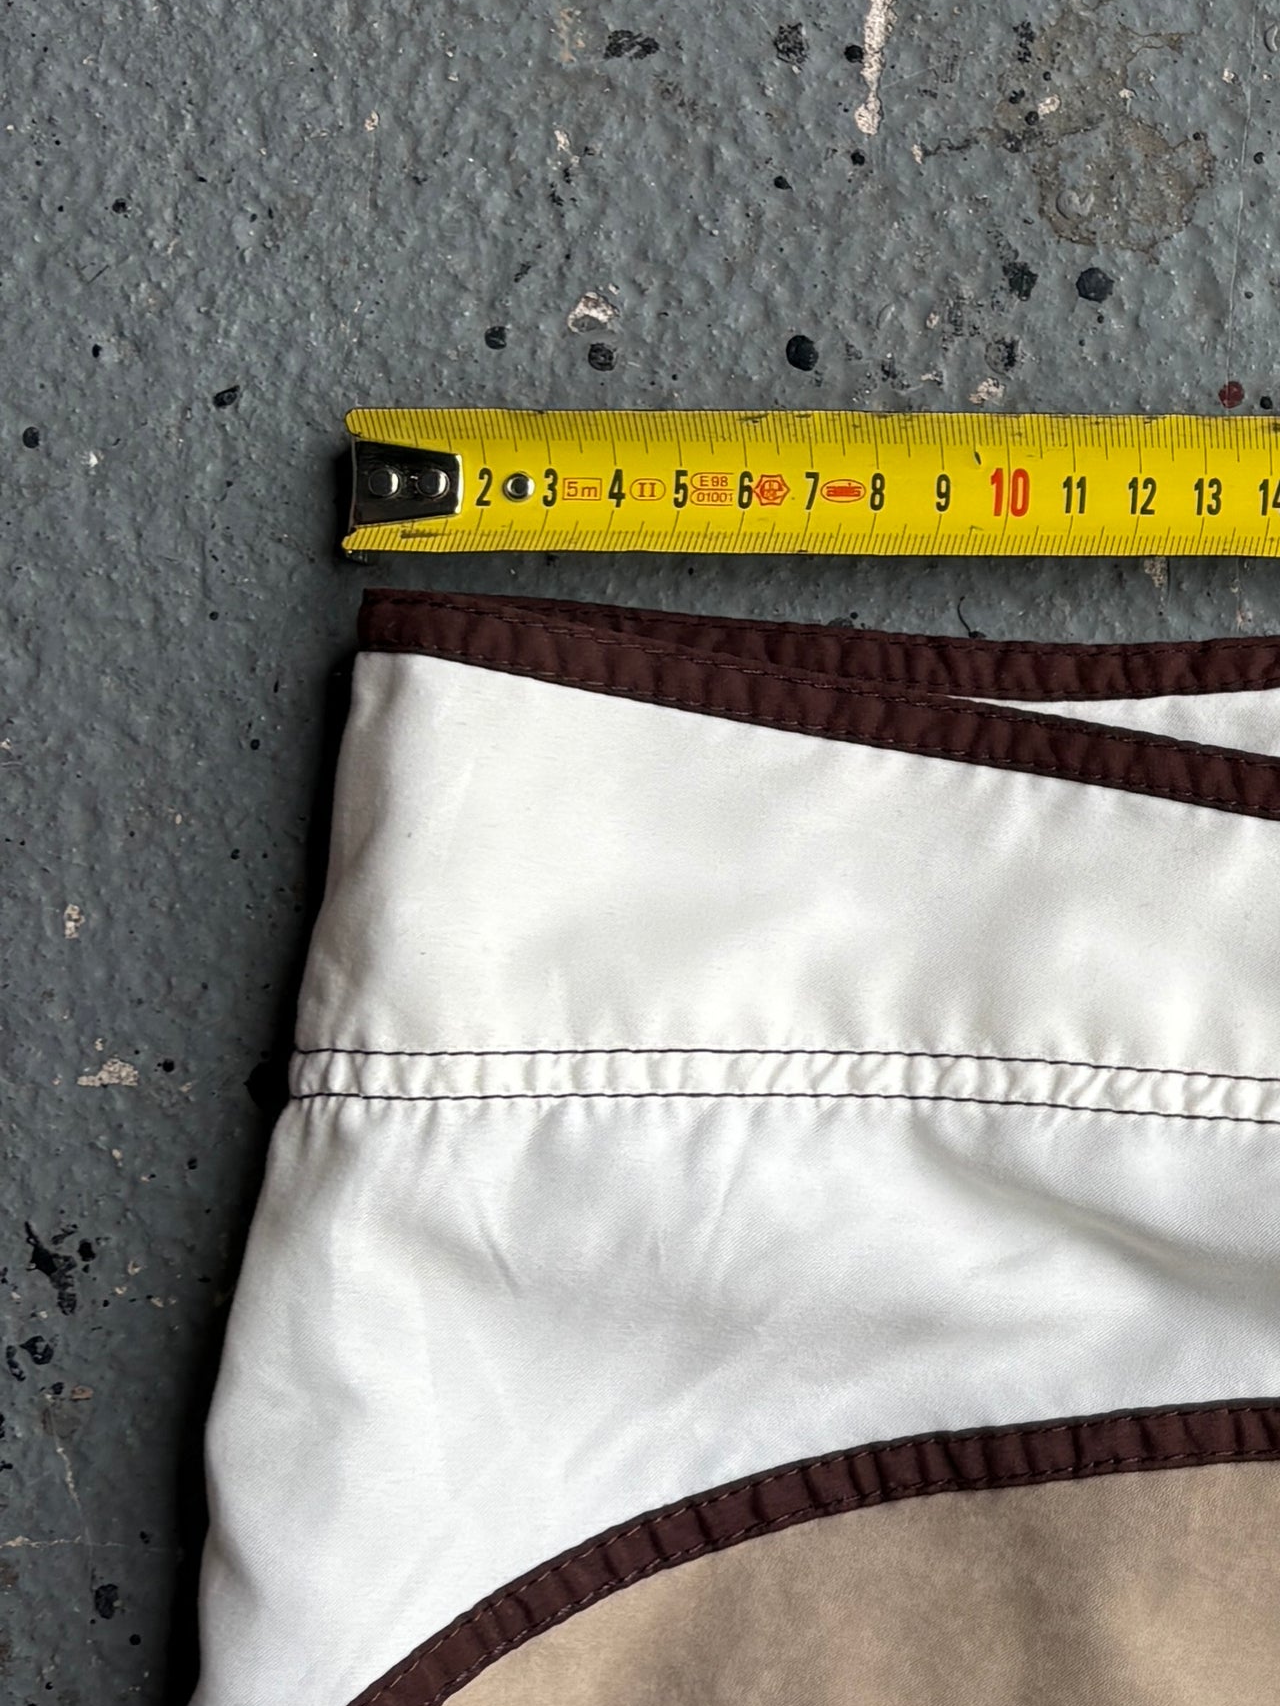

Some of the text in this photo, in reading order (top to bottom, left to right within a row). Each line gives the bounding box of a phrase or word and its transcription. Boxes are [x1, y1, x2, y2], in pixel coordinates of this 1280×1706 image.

[475, 467, 493, 507] 2
[542, 468, 558, 507] 3
[608, 468, 626, 508] 4
[673, 469, 689, 509] 5
[737, 470, 754, 510] 6
[805, 471, 820, 511] 7
[869, 472, 885, 511] 8
[935, 474, 951, 512] 9
[990, 467, 1030, 517] 10
[1062, 476, 1086, 514] 11
[1128, 476, 1157, 515] 12
[1194, 478, 1222, 516] 13
[566, 480, 598, 498] 5m
